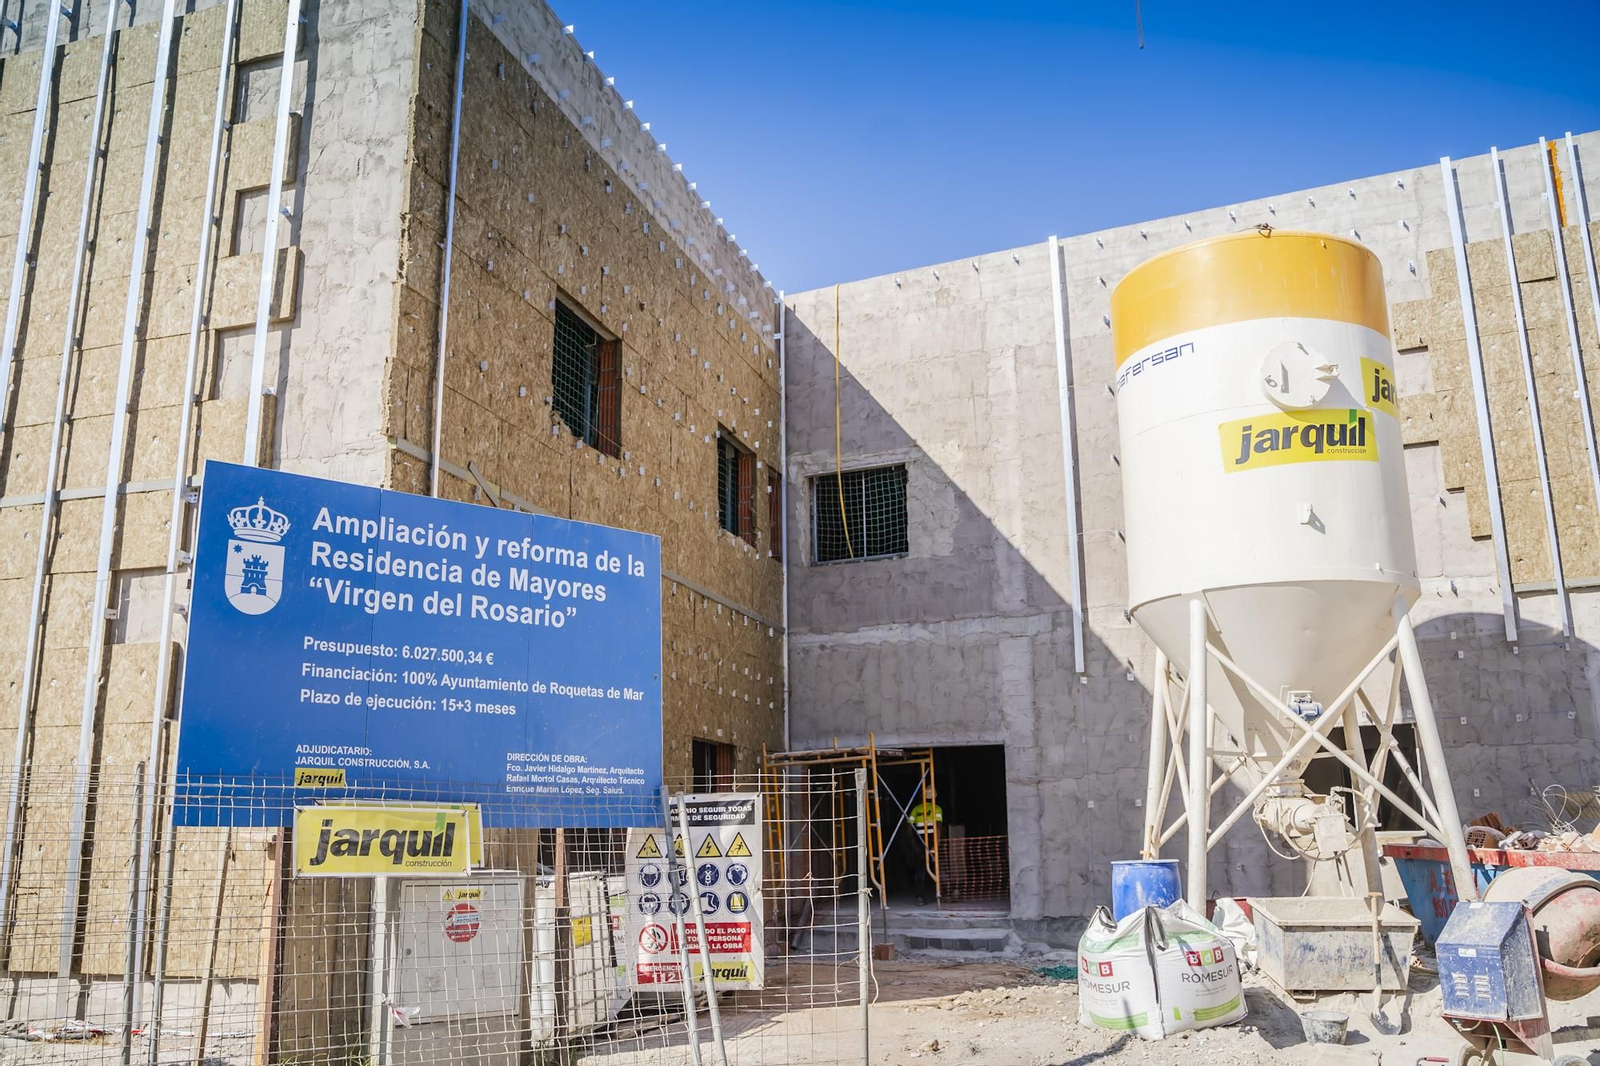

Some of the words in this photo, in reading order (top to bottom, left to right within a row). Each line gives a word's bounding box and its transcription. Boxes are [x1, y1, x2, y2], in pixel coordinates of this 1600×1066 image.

[1372, 368, 1399, 410] jar
[1235, 417, 1366, 465] jarquil
[312, 506, 467, 551] Ampliación
[475, 535, 490, 559] y
[497, 537, 588, 569] reforma
[595, 550, 621, 573] de
[628, 554, 645, 577] la
[311, 541, 463, 584] Residencia
[471, 563, 501, 588] de
[509, 567, 607, 602] Mayores
[309, 576, 414, 615] “Virgen
[423, 591, 462, 617] del
[470, 594, 577, 628] Rosario”
[303, 636, 398, 658] Presupuesto:
[402, 645, 483, 665] 6.027.500,34
[485, 652, 494, 666] €
[302, 662, 398, 684] Financiación:
[402, 671, 438, 687] 100%
[440, 673, 529, 693] Ayuntamiento
[532, 681, 547, 694] de
[550, 681, 604, 699] Roquetas
[607, 687, 621, 699] de
[623, 687, 644, 701] Mar
[300, 688, 341, 704] Plazo
[344, 692, 362, 706] de
[366, 695, 437, 711] ejecución:
[441, 698, 472, 713] 15+3
[475, 702, 517, 716] meses
[295, 744, 373, 757] ADJUDICATARIO:
[506, 752, 550, 763] DIRECCIÓN
[551, 755, 562, 763] DE
[563, 755, 588, 764] OBRA:
[294, 756, 336, 767] JARQUIL
[337, 757, 412, 770] CONSTRUCCIÓN,
[413, 760, 431, 770] S.A.
[506, 764, 523, 772] Fco.
[524, 765, 547, 773] Javier
[548, 765, 576, 775] Hidalgo
[609, 767, 645, 776] Arquitecto
[298, 772, 343, 786] jarquil
[555, 775, 580, 784] Casas,
[581, 776, 618, 786] Arquitecto
[619, 777, 645, 785] Técnico
[698, 806, 727, 814] SEGUIR
[728, 805, 752, 813] TODAS
[703, 812, 746, 821] SEGURIDAD
[309, 818, 456, 866] jarquil
[405, 859, 453, 868] construcción
[1182, 965, 1233, 983] ROMESUR
